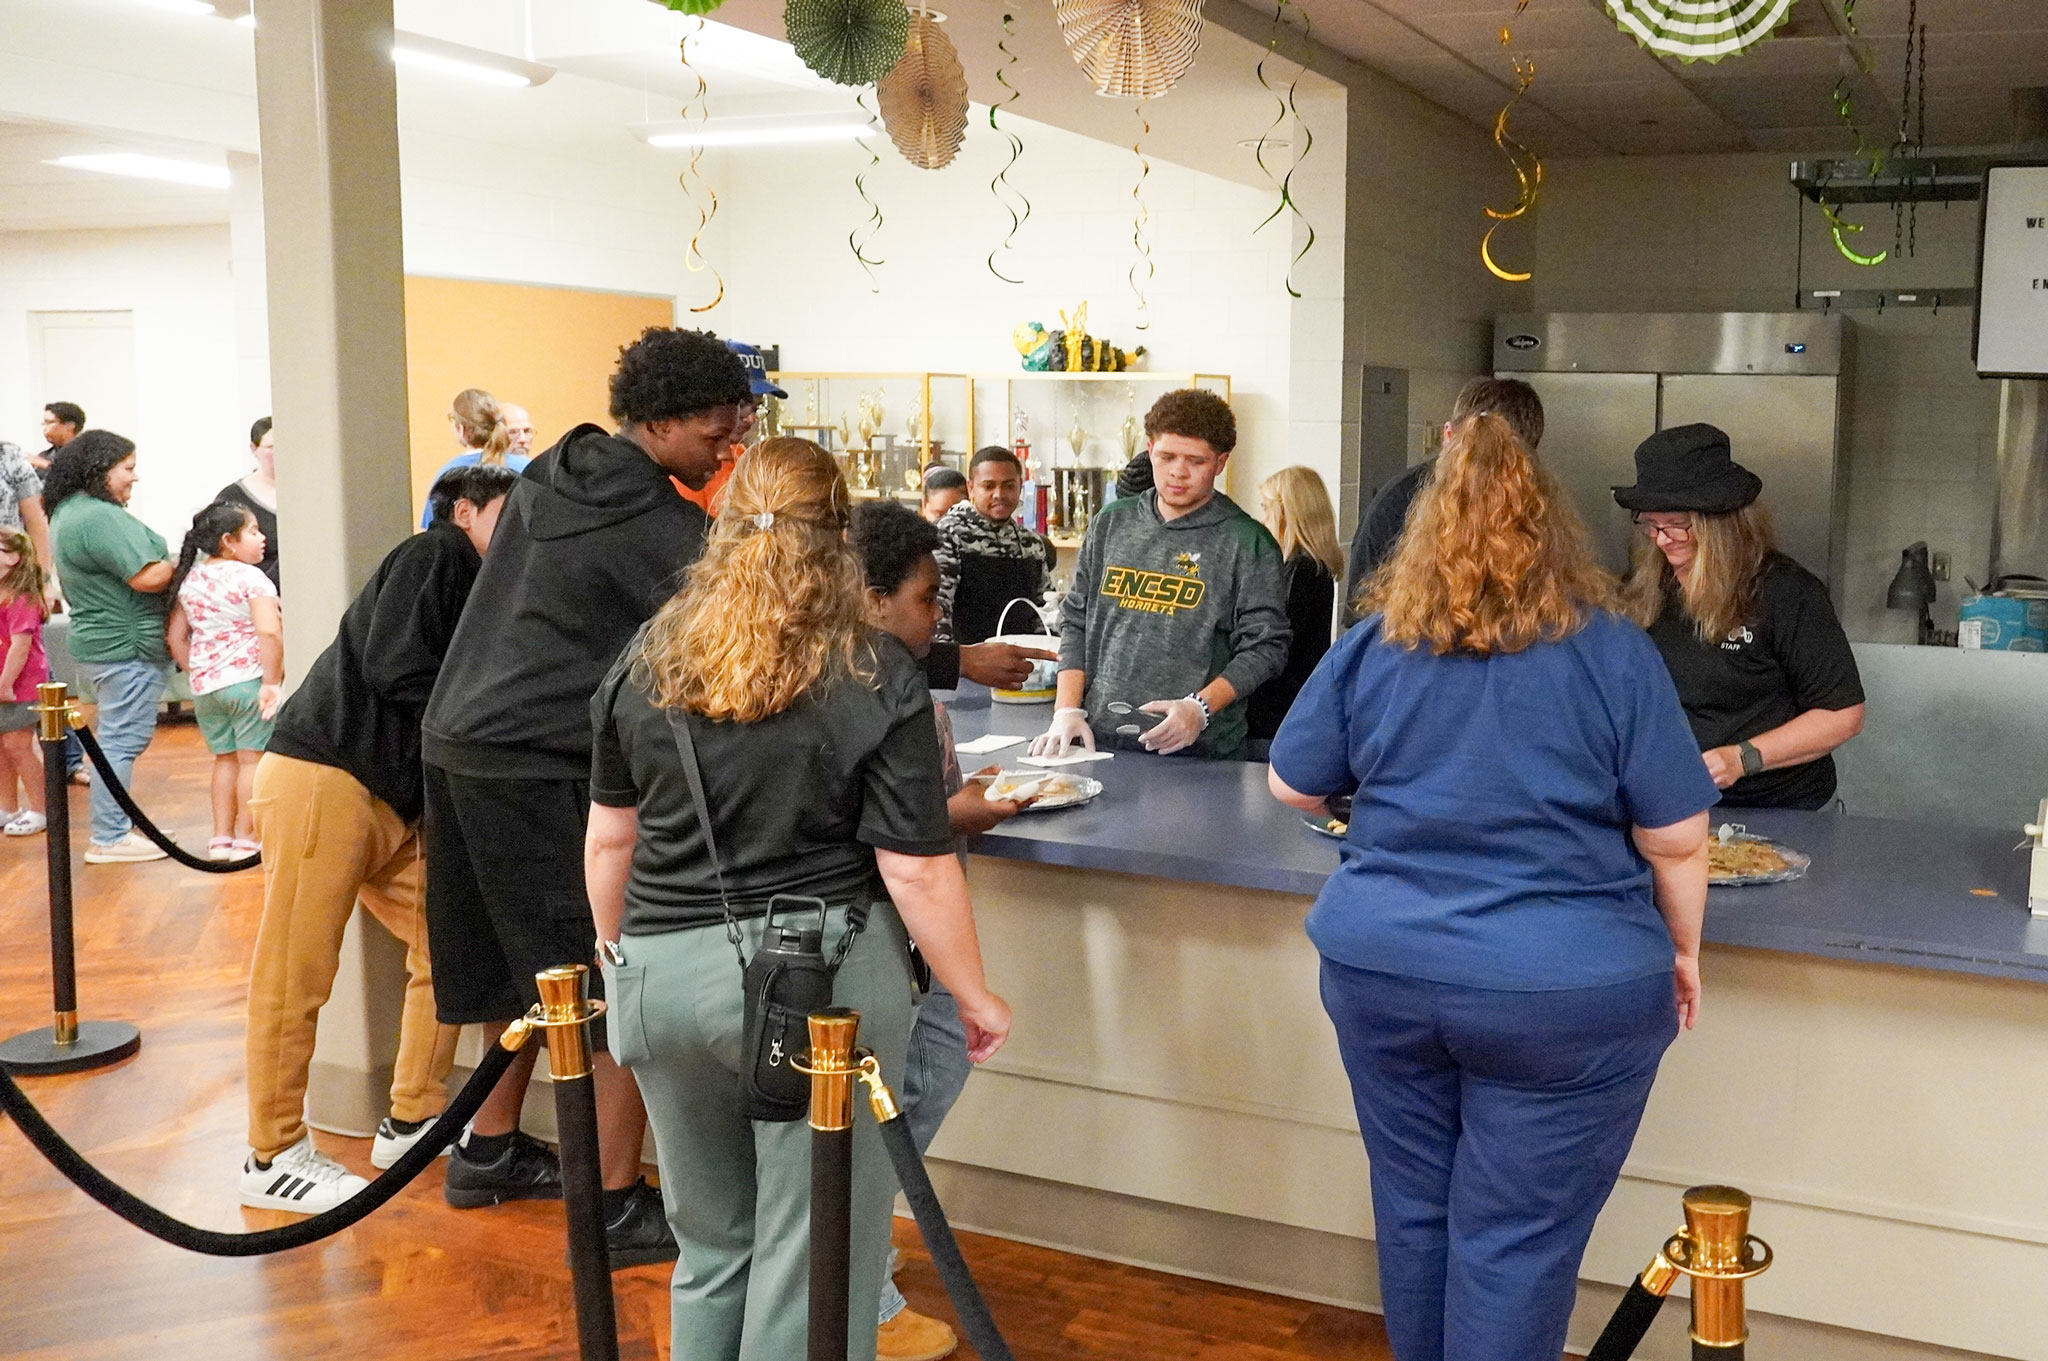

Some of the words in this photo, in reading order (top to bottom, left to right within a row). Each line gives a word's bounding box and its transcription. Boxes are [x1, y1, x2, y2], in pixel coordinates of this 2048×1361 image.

[2026, 217, 2045, 228] WE
[1101, 565, 1206, 609] ENCSD
[1119, 598, 1177, 616] HORNETS
[1721, 642, 1741, 651] STAFF
